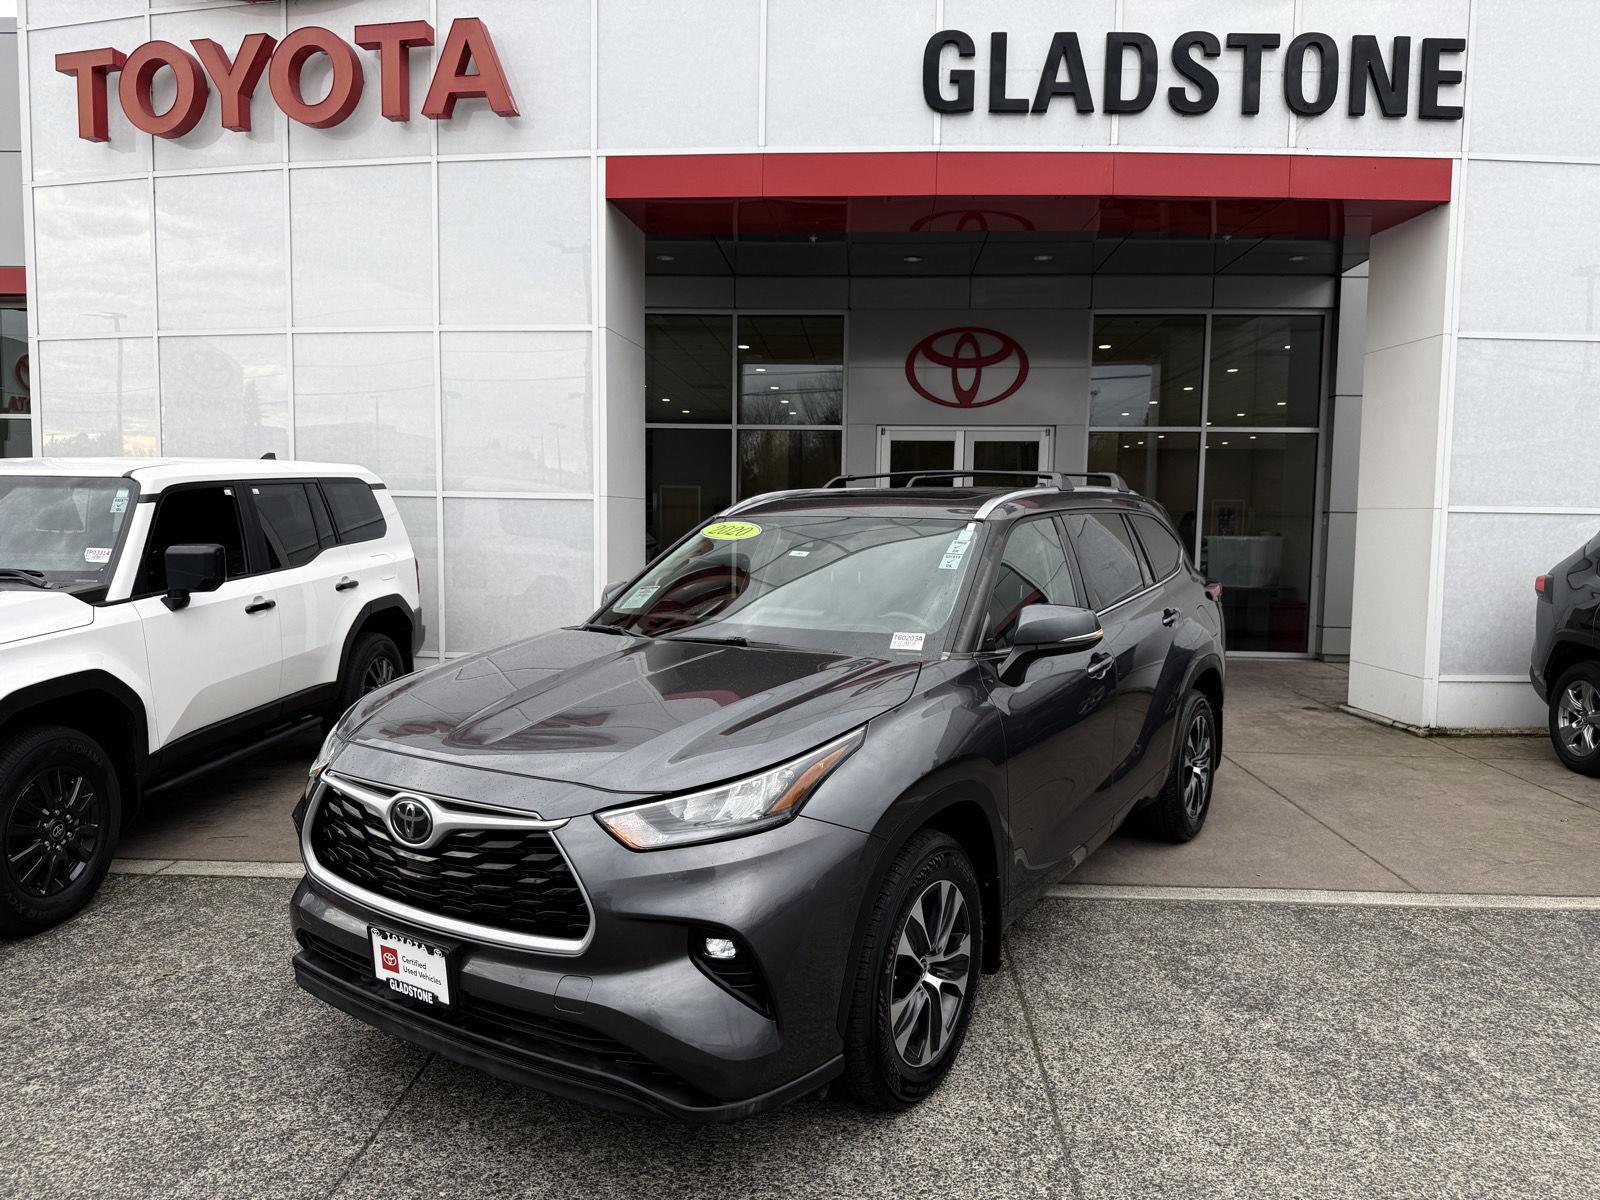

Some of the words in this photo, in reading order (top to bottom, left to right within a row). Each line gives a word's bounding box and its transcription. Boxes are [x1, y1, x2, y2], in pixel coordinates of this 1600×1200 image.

[56, 17, 519, 142] TOYOTA
[922, 30, 1466, 121] GLADSTONE
[708, 525, 754, 537] 2020
[894, 633, 923, 642] T60203A
[386, 932, 427, 951] TOYOTA
[401, 955, 427, 970] Certified
[402, 966, 418, 977] Used
[418, 971, 442, 986] Vehicles
[389, 978, 434, 1004] GLADSTONE
